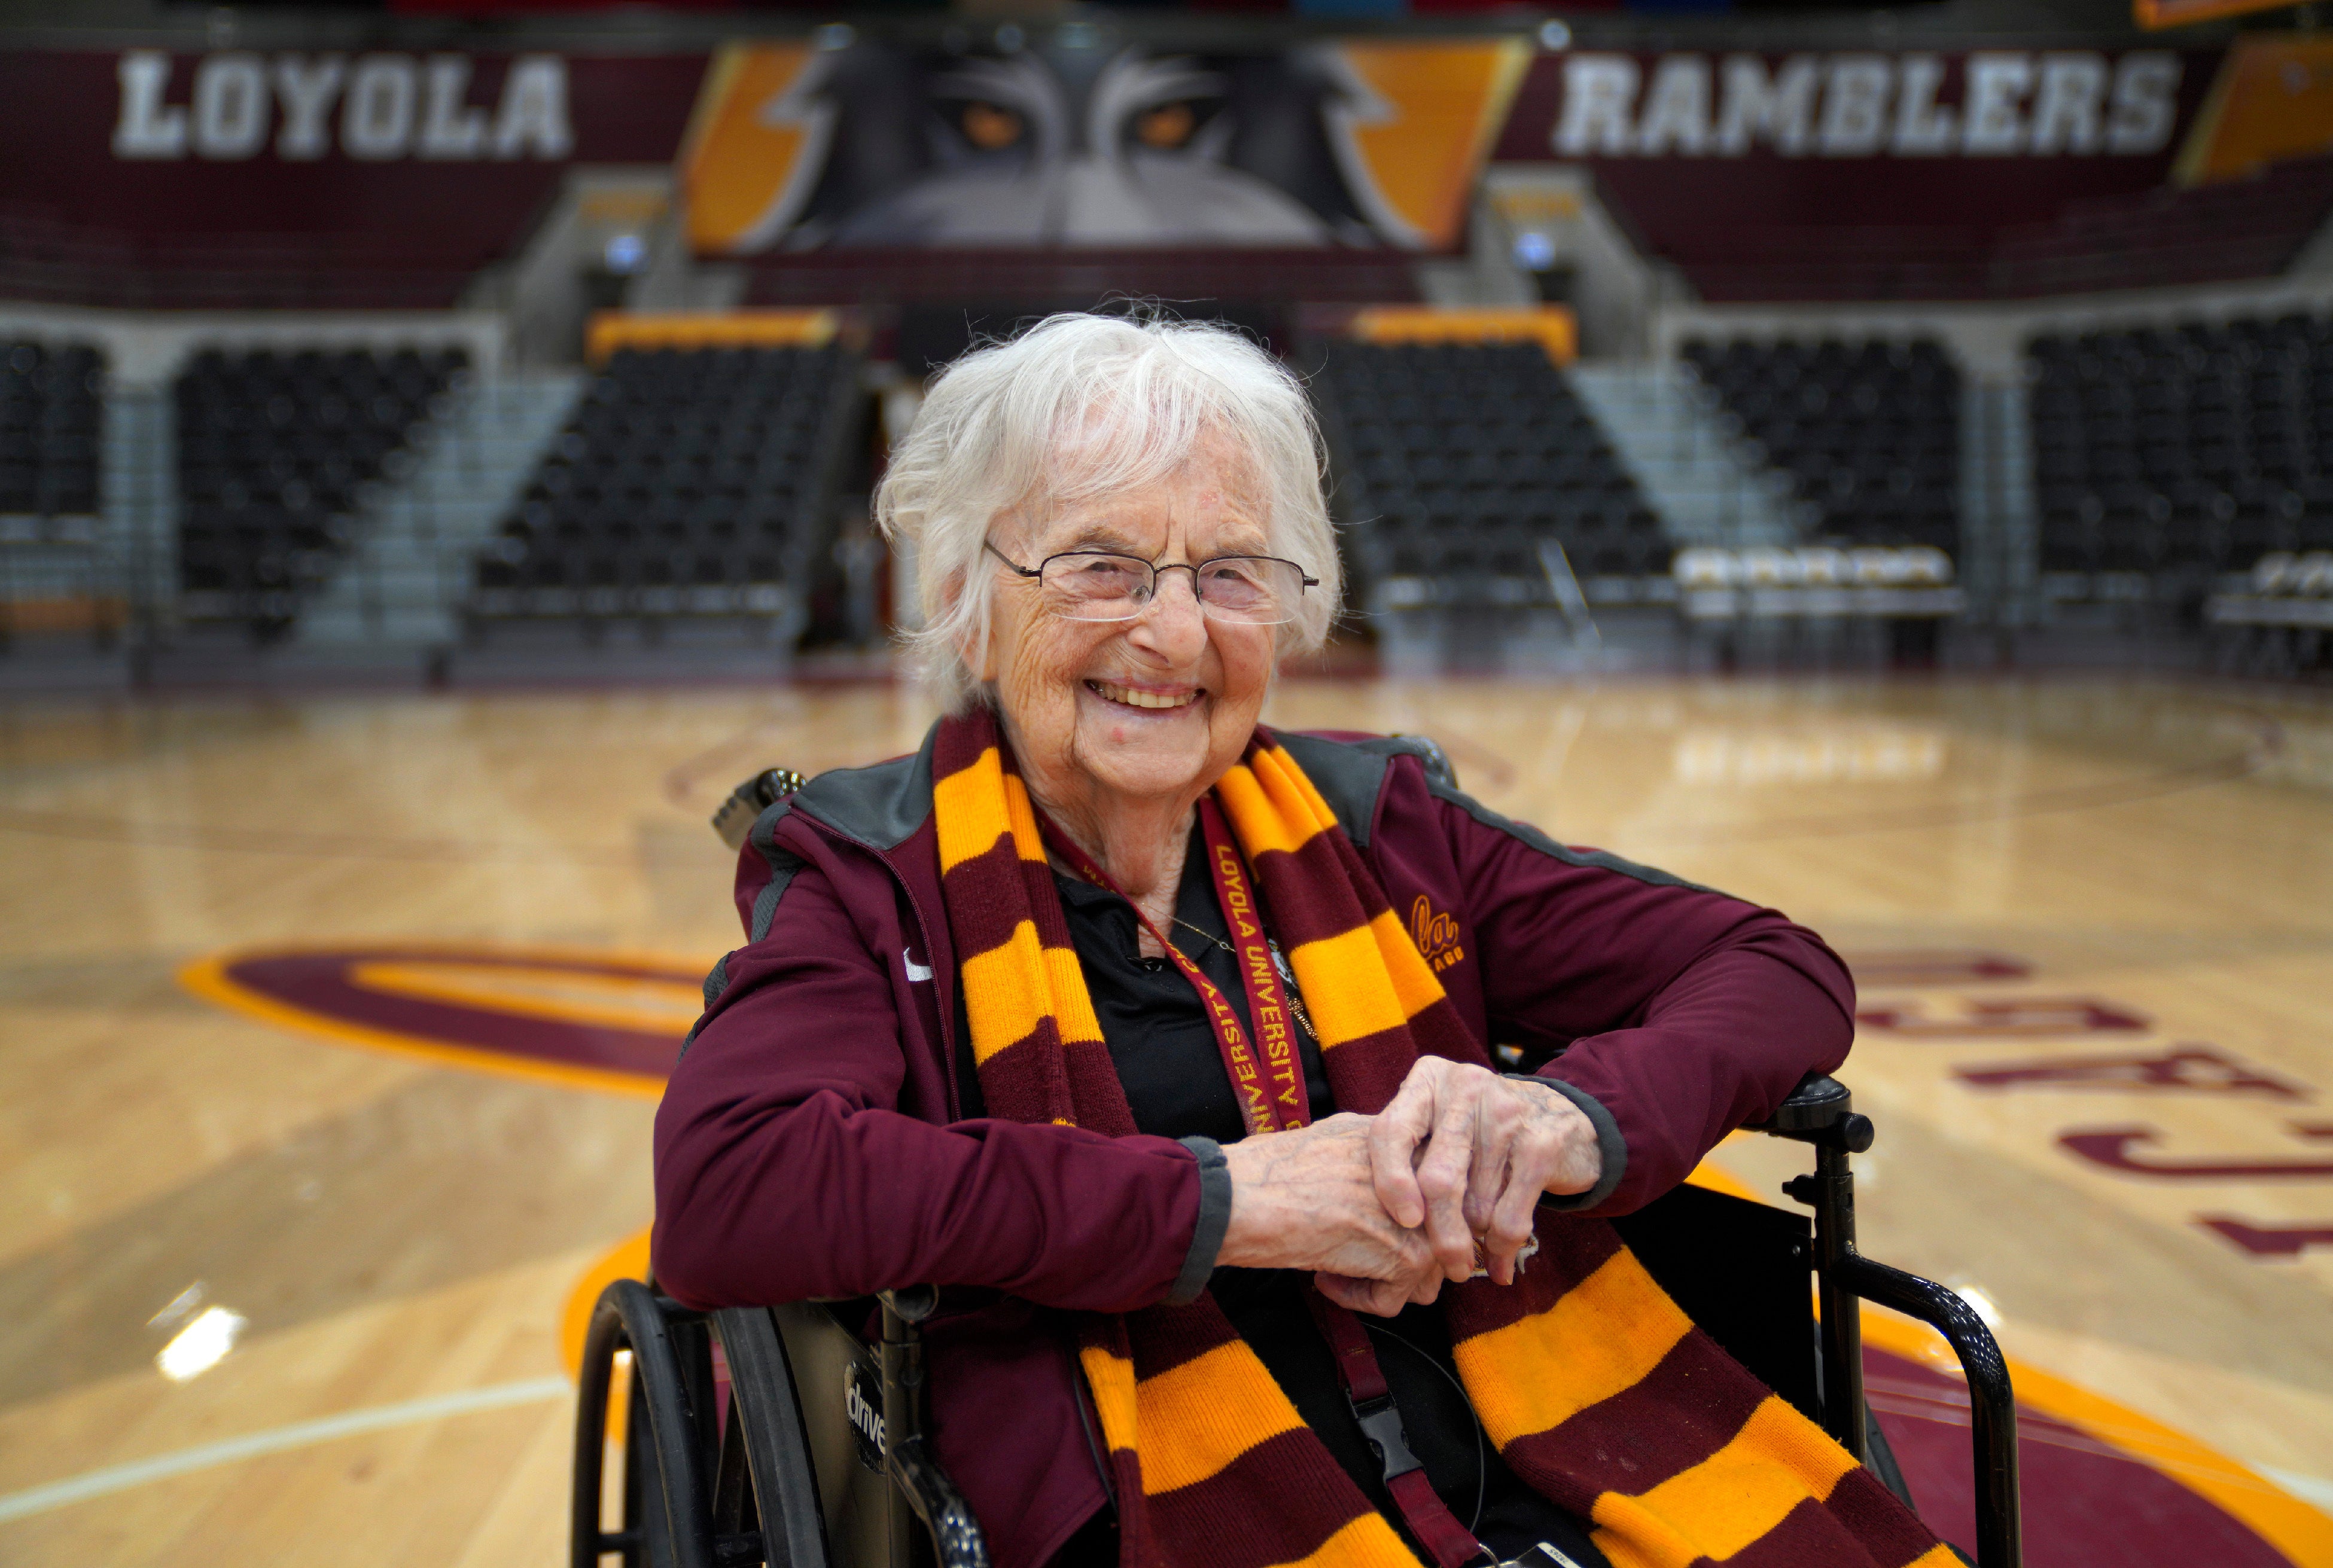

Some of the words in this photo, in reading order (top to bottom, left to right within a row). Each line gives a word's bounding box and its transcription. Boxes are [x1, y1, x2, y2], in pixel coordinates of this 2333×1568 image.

[112, 53, 574, 160] LOYOLA
[1553, 53, 2183, 157] RAMBLERS
[1216, 844, 1256, 938] LOYOLA
[1246, 945, 1299, 1106] UNIVERSITY
[1201, 980, 1275, 1135] NIVERSITY
[847, 1381, 887, 1456] drive
